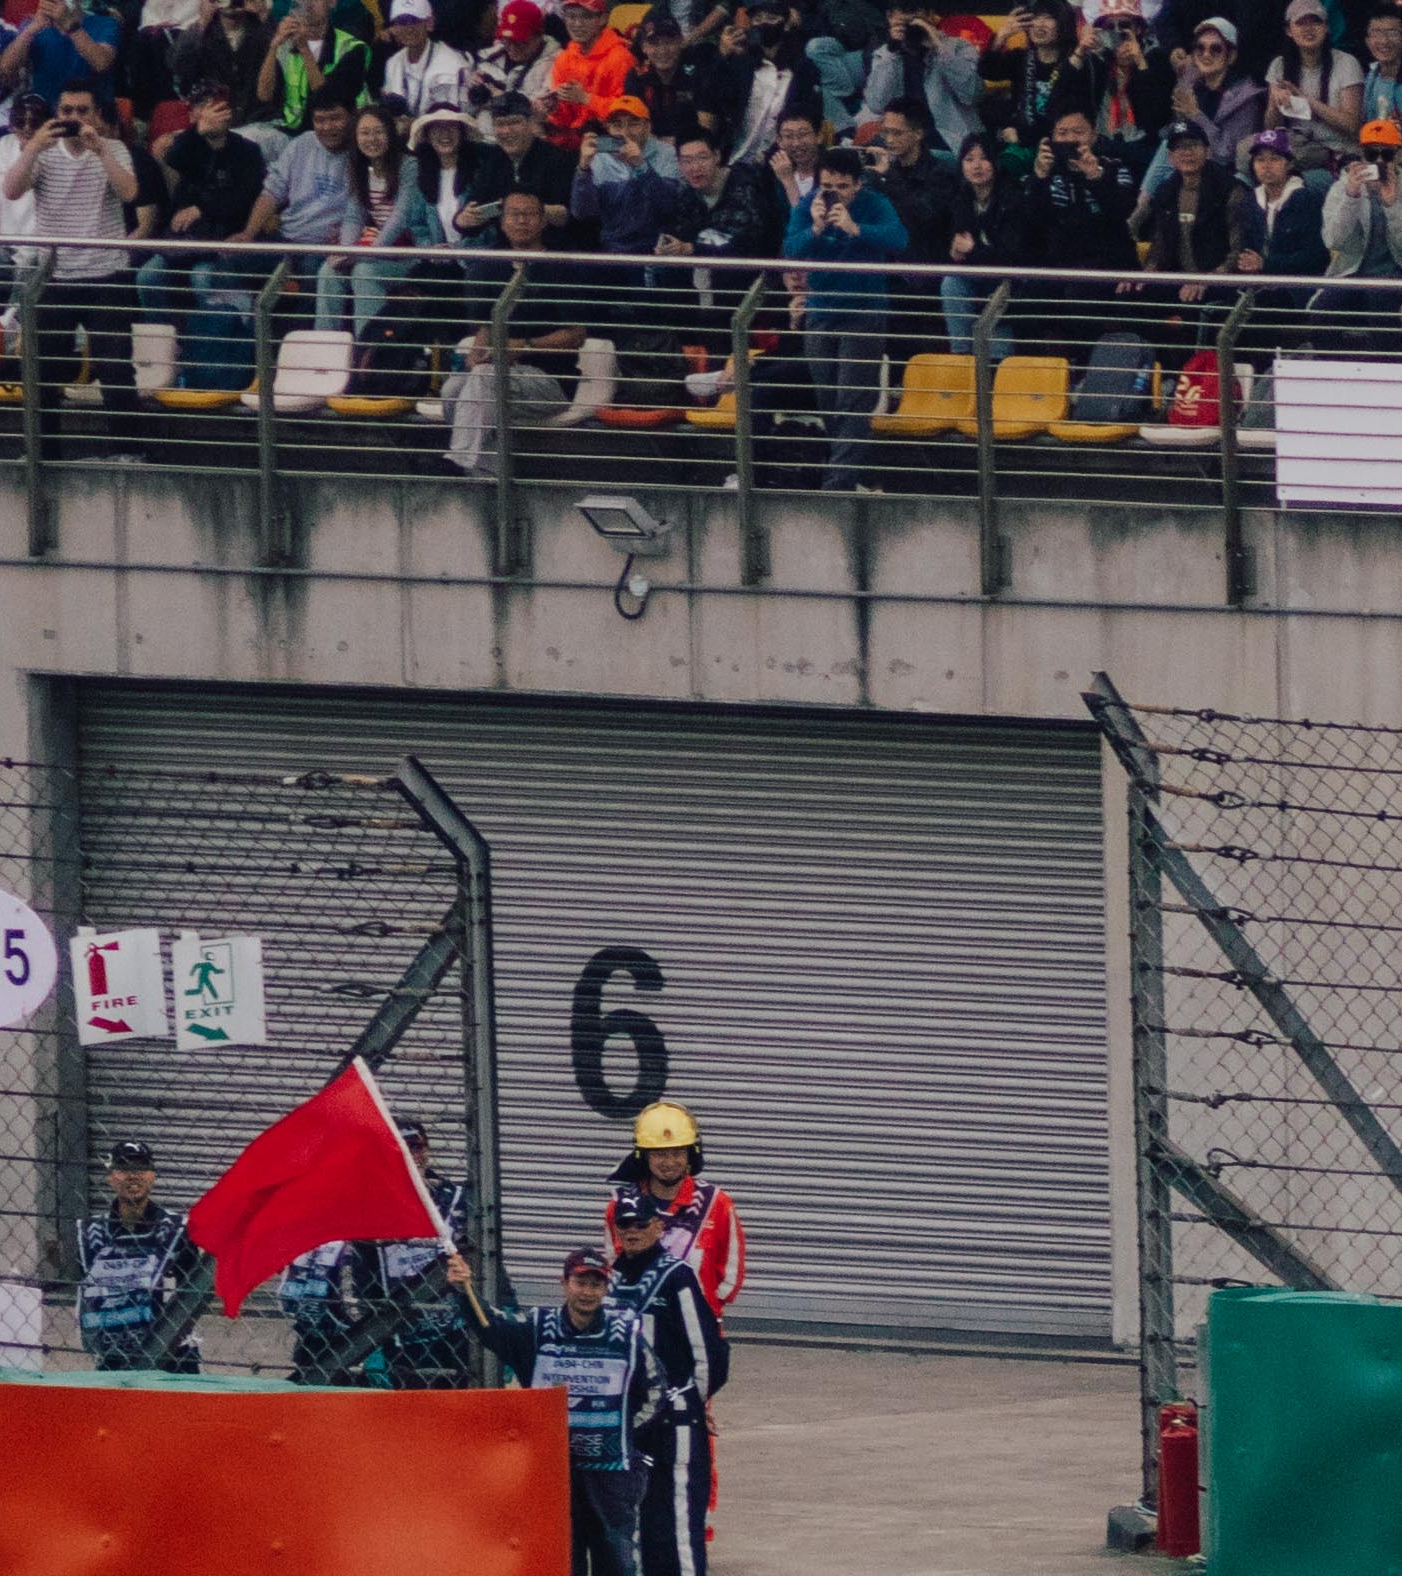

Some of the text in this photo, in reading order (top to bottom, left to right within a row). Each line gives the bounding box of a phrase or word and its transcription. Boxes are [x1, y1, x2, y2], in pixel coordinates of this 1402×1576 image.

[91, 995, 139, 1012] FIRE
[185, 1005, 236, 1020] EXIT
[571, 945, 669, 1119] 6
[569, 1385, 599, 1394] RSHAL
